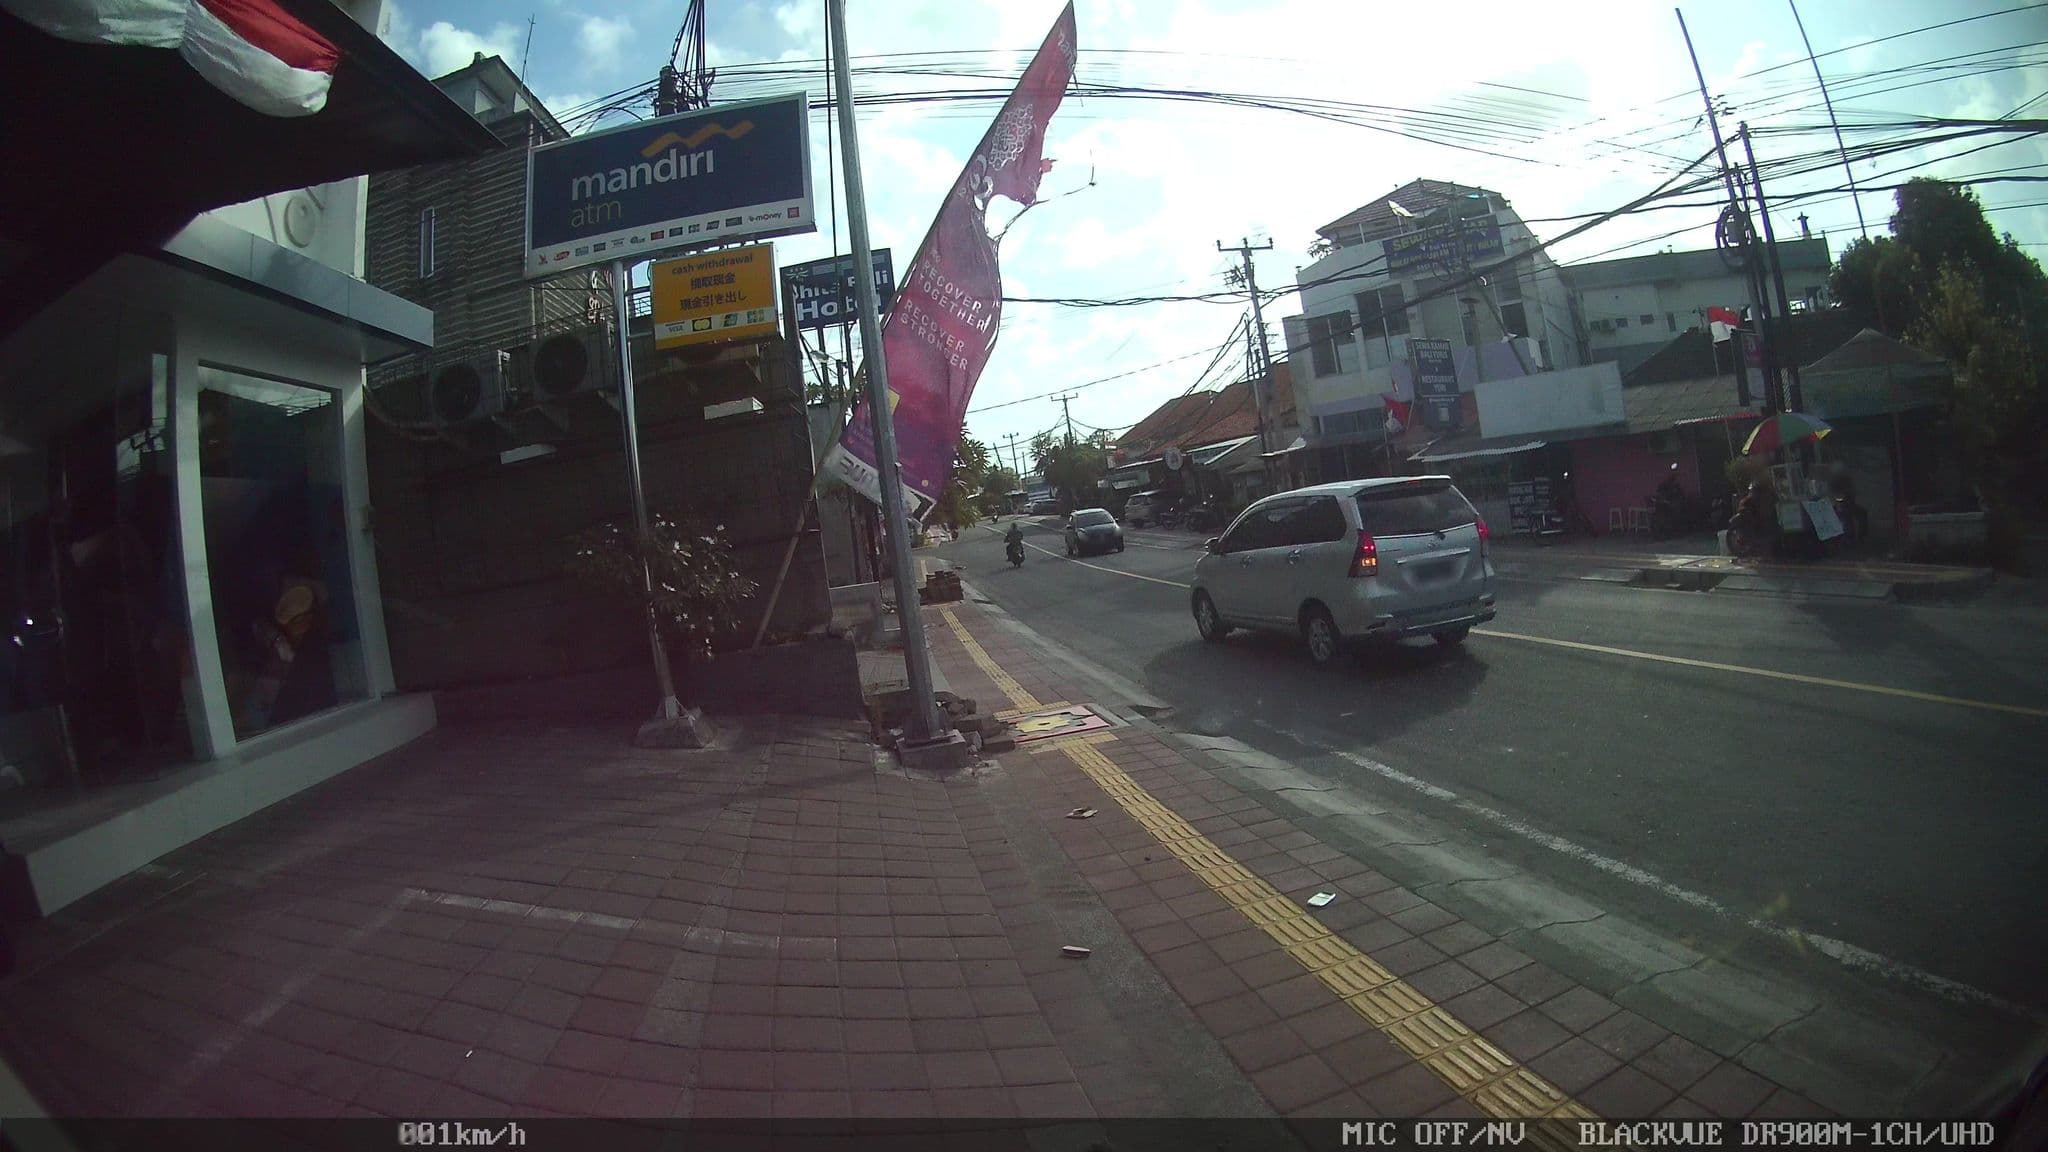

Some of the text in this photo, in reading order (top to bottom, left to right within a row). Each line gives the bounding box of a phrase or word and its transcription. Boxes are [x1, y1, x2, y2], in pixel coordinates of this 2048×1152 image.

[571, 149, 714, 201] mandiri
[571, 200, 622, 228] atm
[671, 254, 753, 276] cash withdrawal
[847, 269, 889, 288] Bli
[922, 261, 982, 314] RECOVER
[903, 299, 965, 352] RECOVER
[919, 273, 985, 333] TOGETHER
